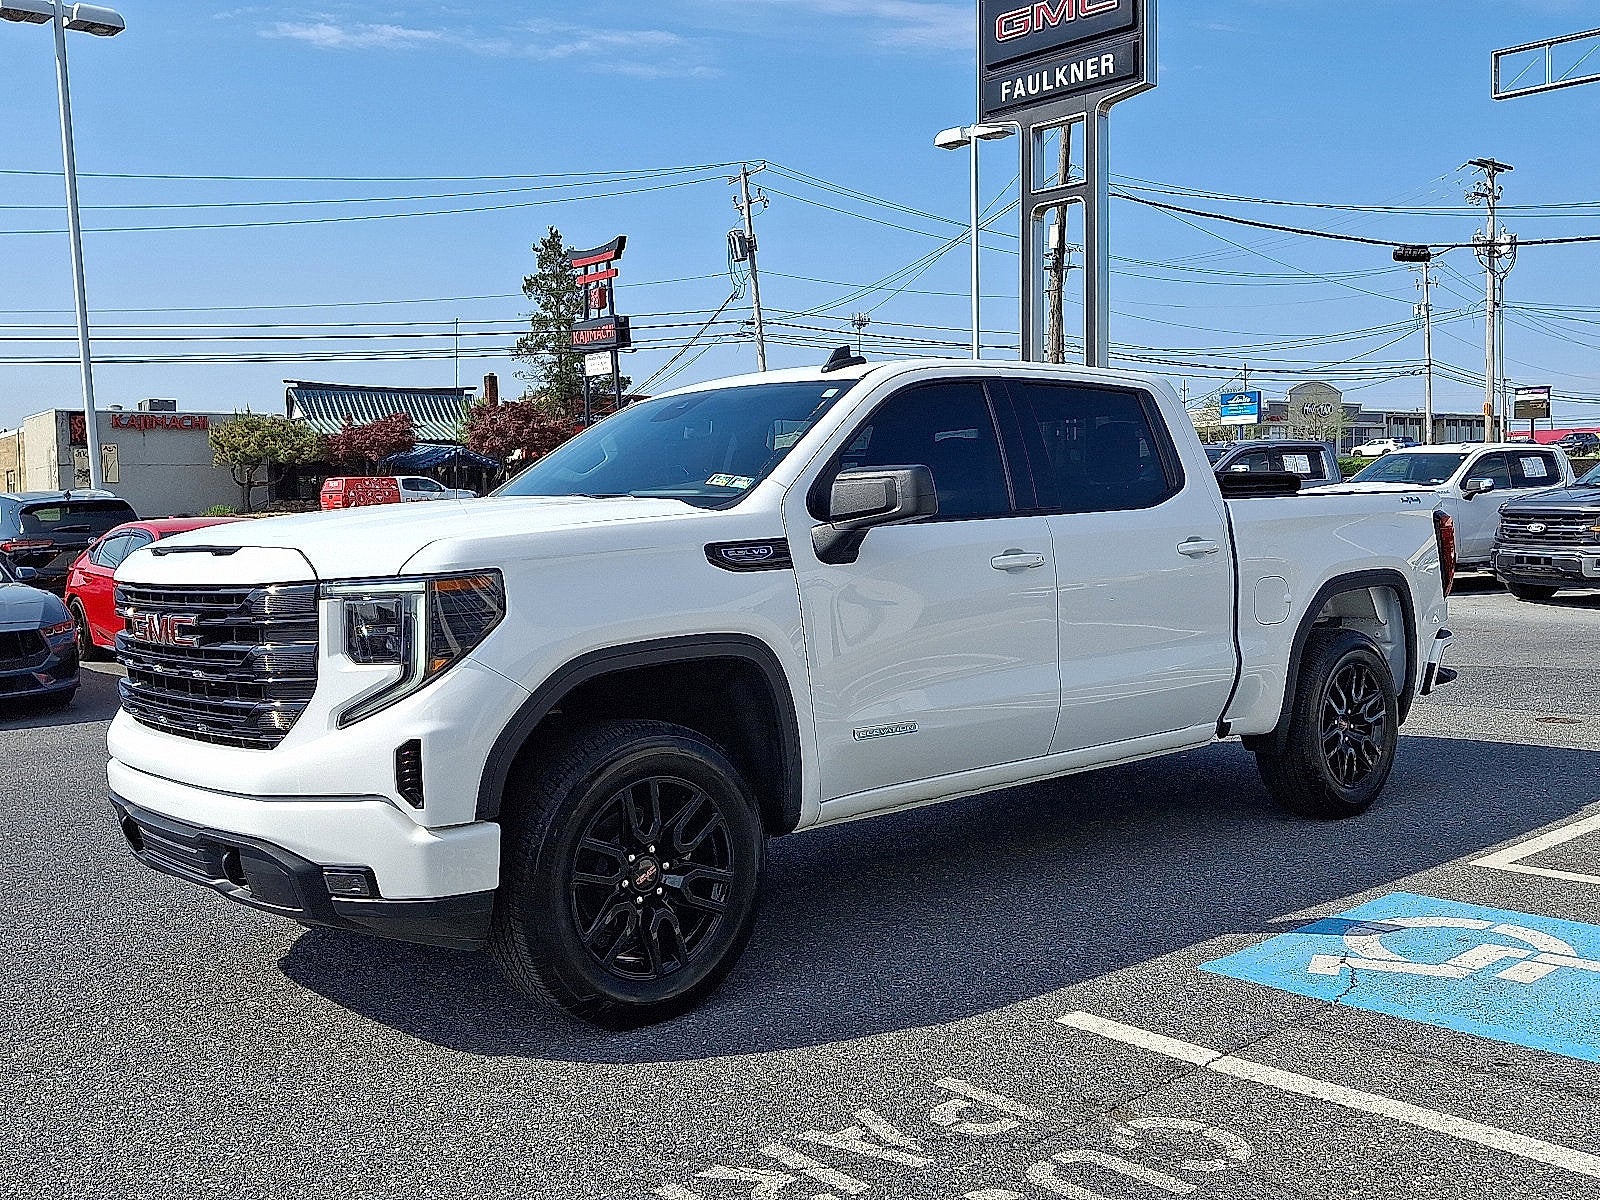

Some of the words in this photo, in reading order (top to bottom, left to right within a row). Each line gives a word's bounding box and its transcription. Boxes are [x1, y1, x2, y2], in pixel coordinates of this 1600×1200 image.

[1000, 53, 1115, 103] FAULKNER
[572, 324, 616, 345] KAJIMACHI
[111, 414, 209, 432] KAJIMACHI
[132, 613, 200, 648] GMC
[855, 722, 917, 738] ELEVATION
